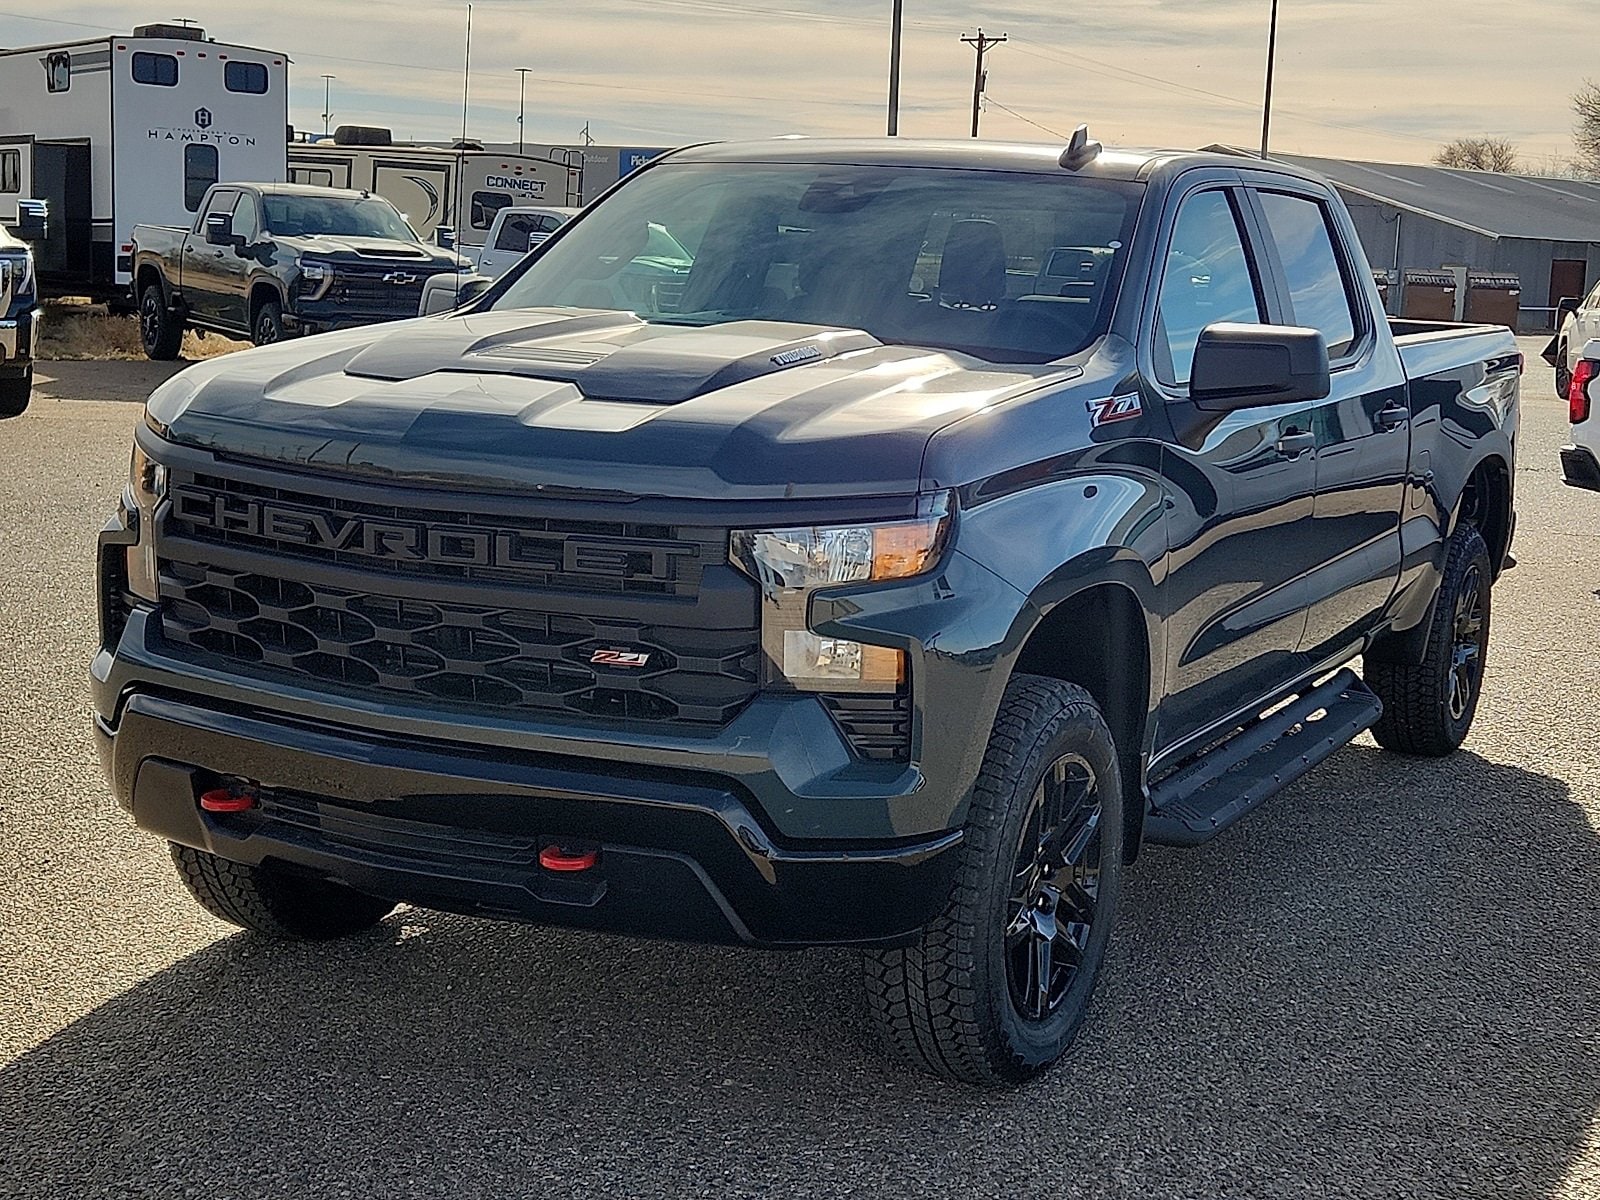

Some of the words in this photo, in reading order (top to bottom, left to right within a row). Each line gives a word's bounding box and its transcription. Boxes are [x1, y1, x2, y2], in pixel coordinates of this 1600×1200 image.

[148, 129, 256, 146] HAMPTON
[486, 175, 547, 193] CONNECT
[1085, 391, 1143, 428] Z71
[173, 487, 697, 580] CHEVROLET
[590, 650, 649, 667] Z71
